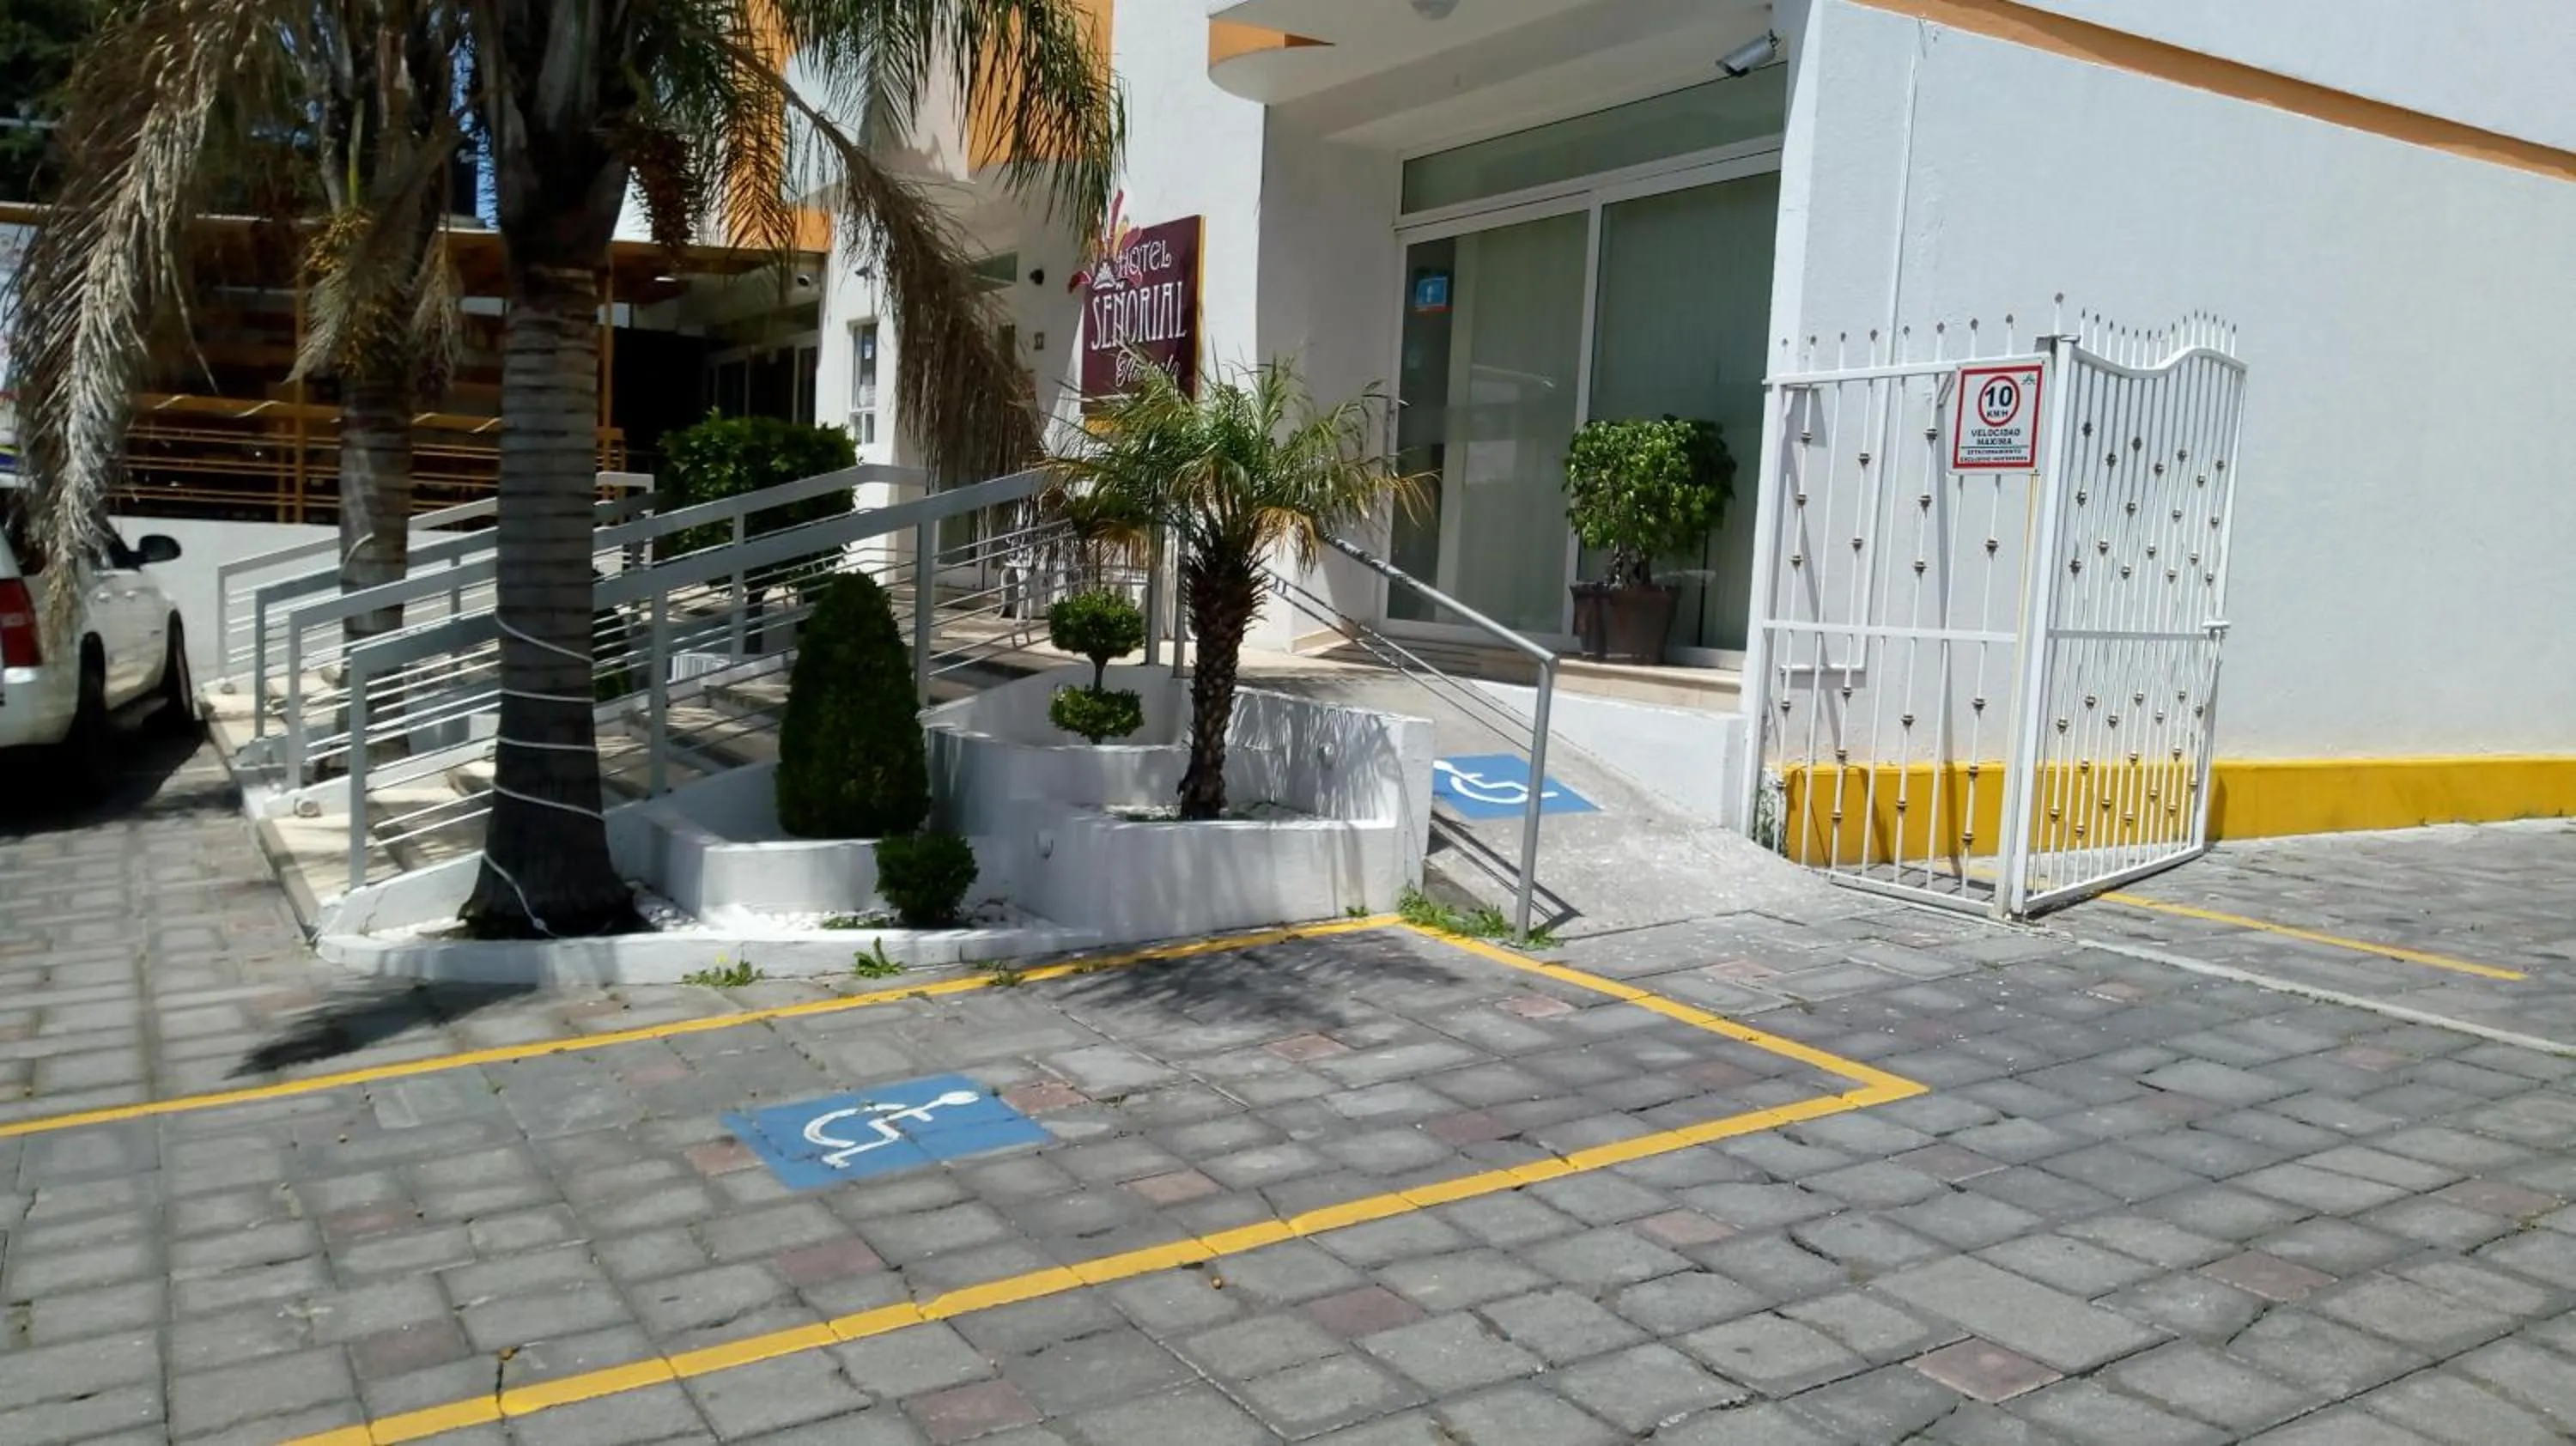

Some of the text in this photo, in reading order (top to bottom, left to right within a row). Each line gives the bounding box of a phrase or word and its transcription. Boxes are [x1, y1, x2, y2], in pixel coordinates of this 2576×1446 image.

[1117, 240, 1171, 277] HOTEL
[1091, 281, 1187, 350] SEÑORIAL
[1984, 386, 2013, 407] 10
[1971, 428, 2020, 437] VELOCIDAD
